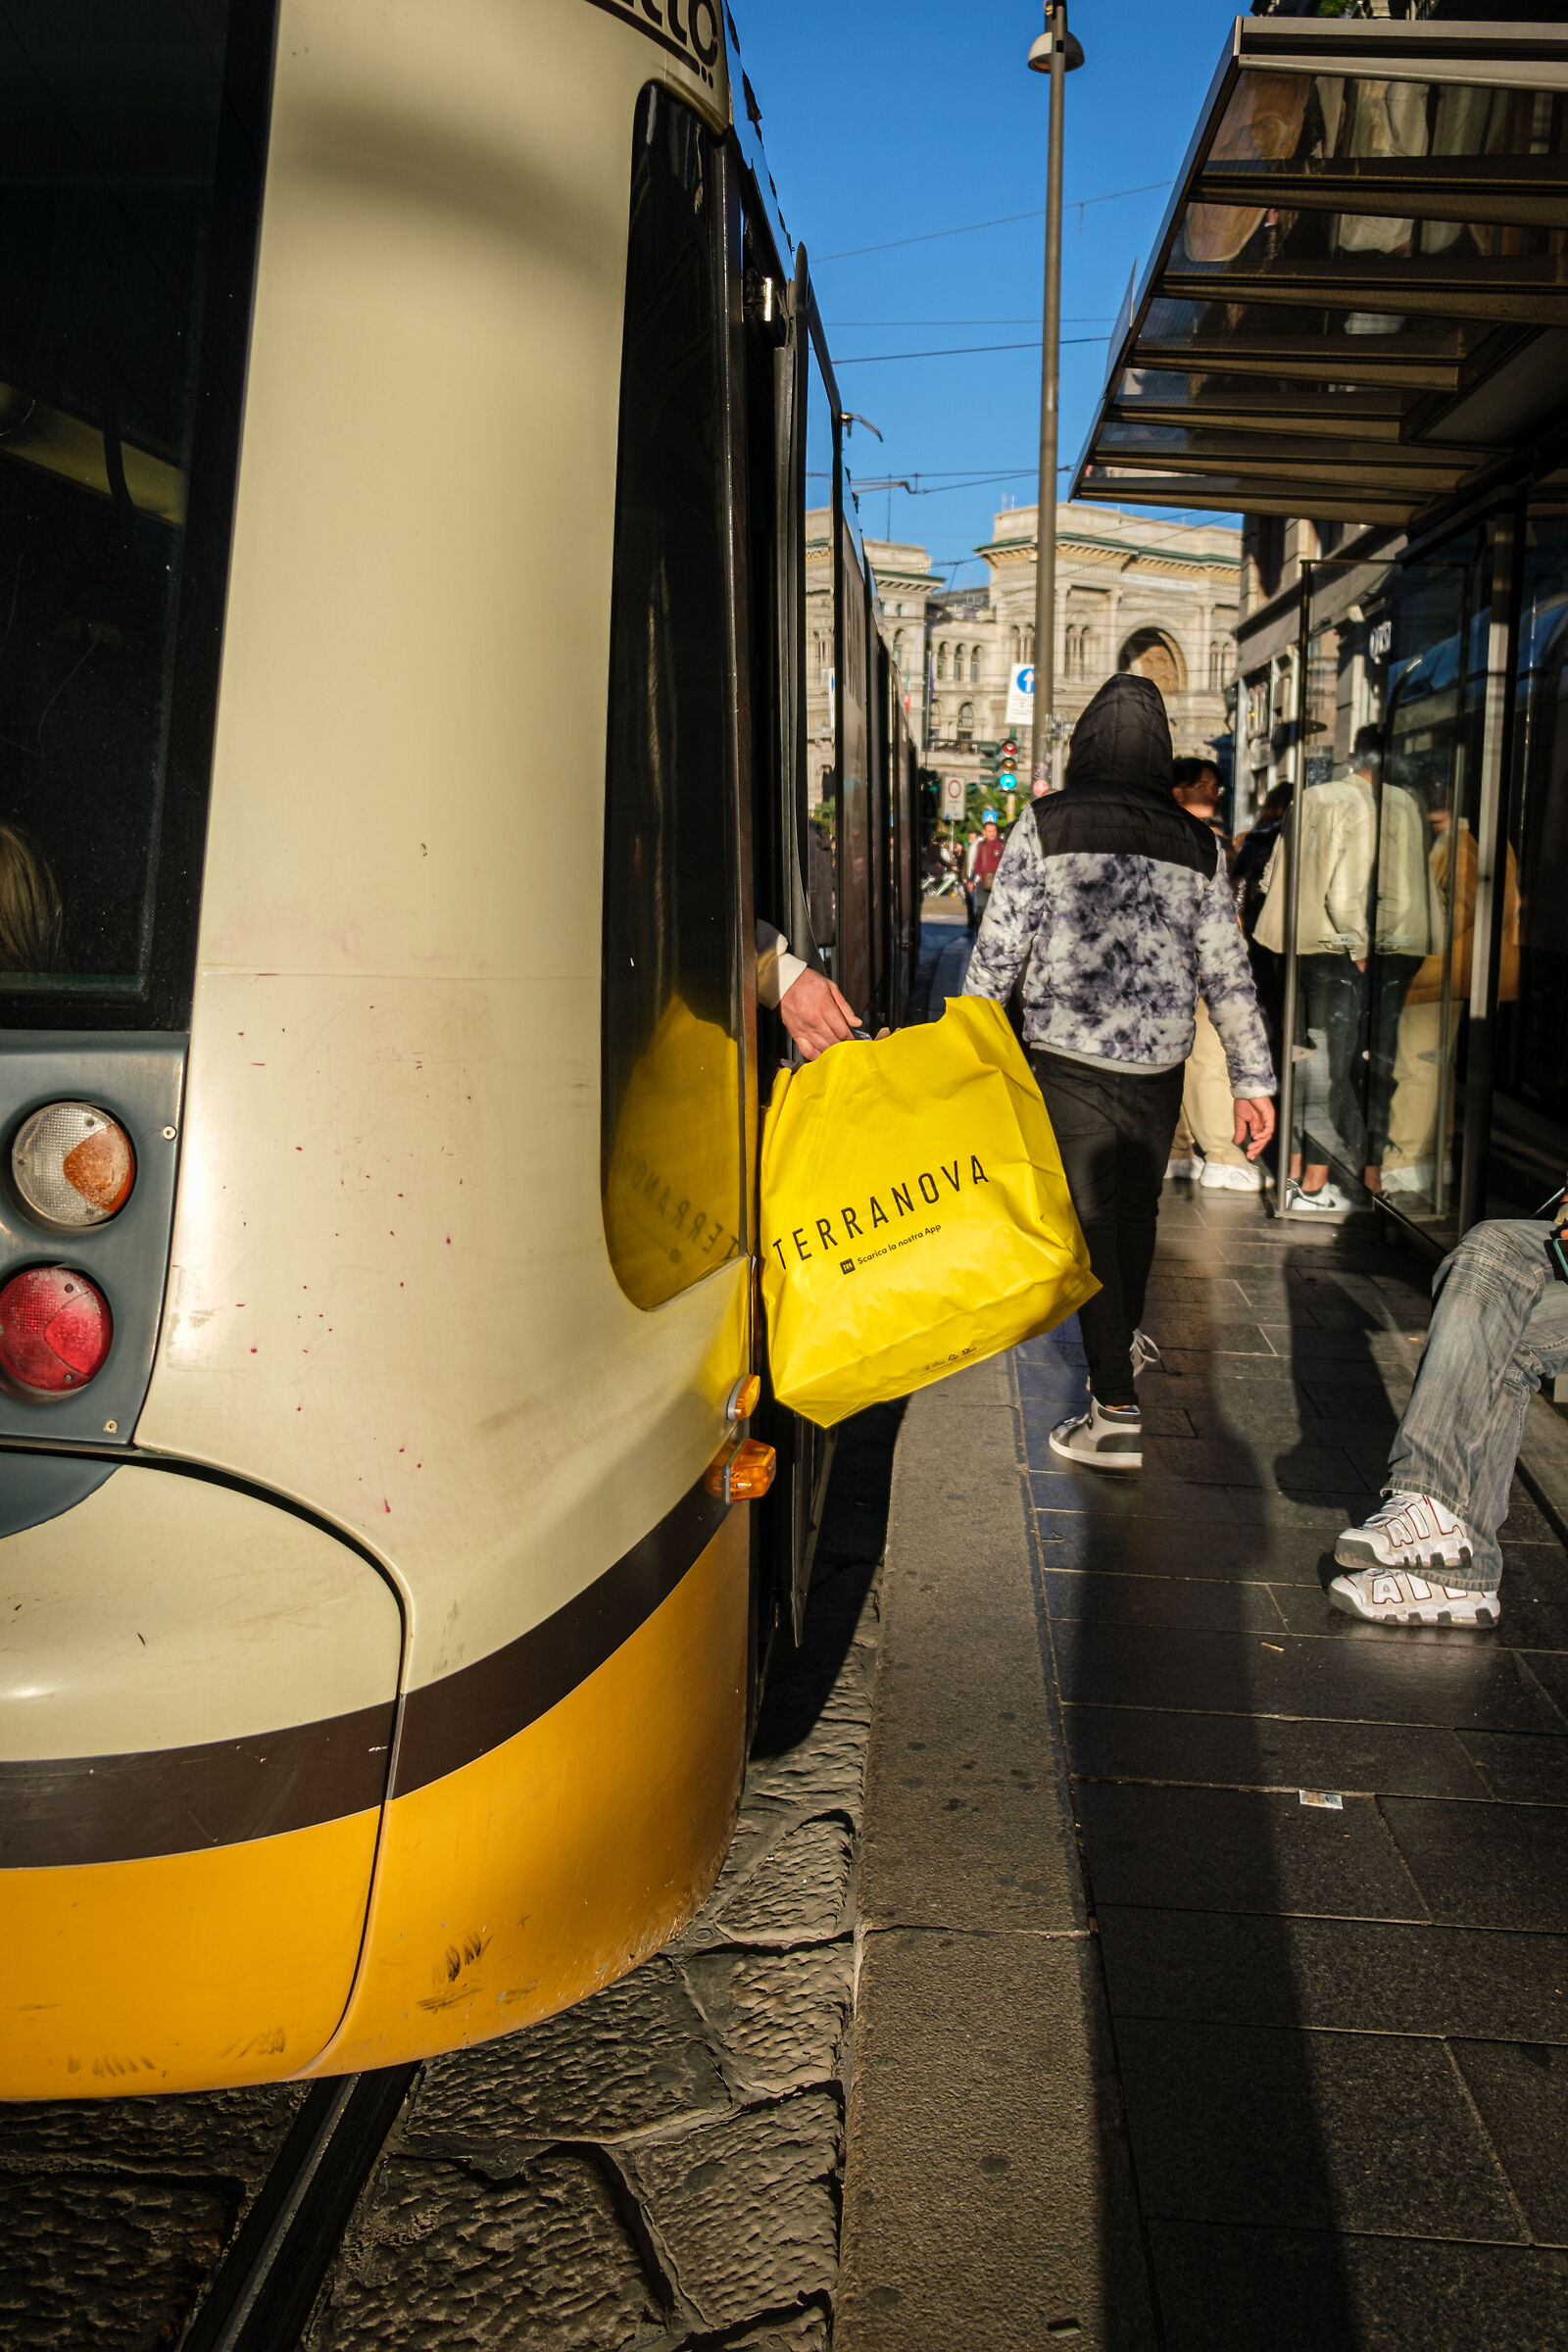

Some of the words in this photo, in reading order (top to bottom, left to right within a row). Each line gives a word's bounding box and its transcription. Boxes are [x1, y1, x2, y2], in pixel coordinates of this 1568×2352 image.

[772, 1154, 990, 1270] TERRANOVA
[857, 1248, 888, 1264] Scarica
[898, 1231, 923, 1247] nostra
[924, 1223, 942, 1236] App
